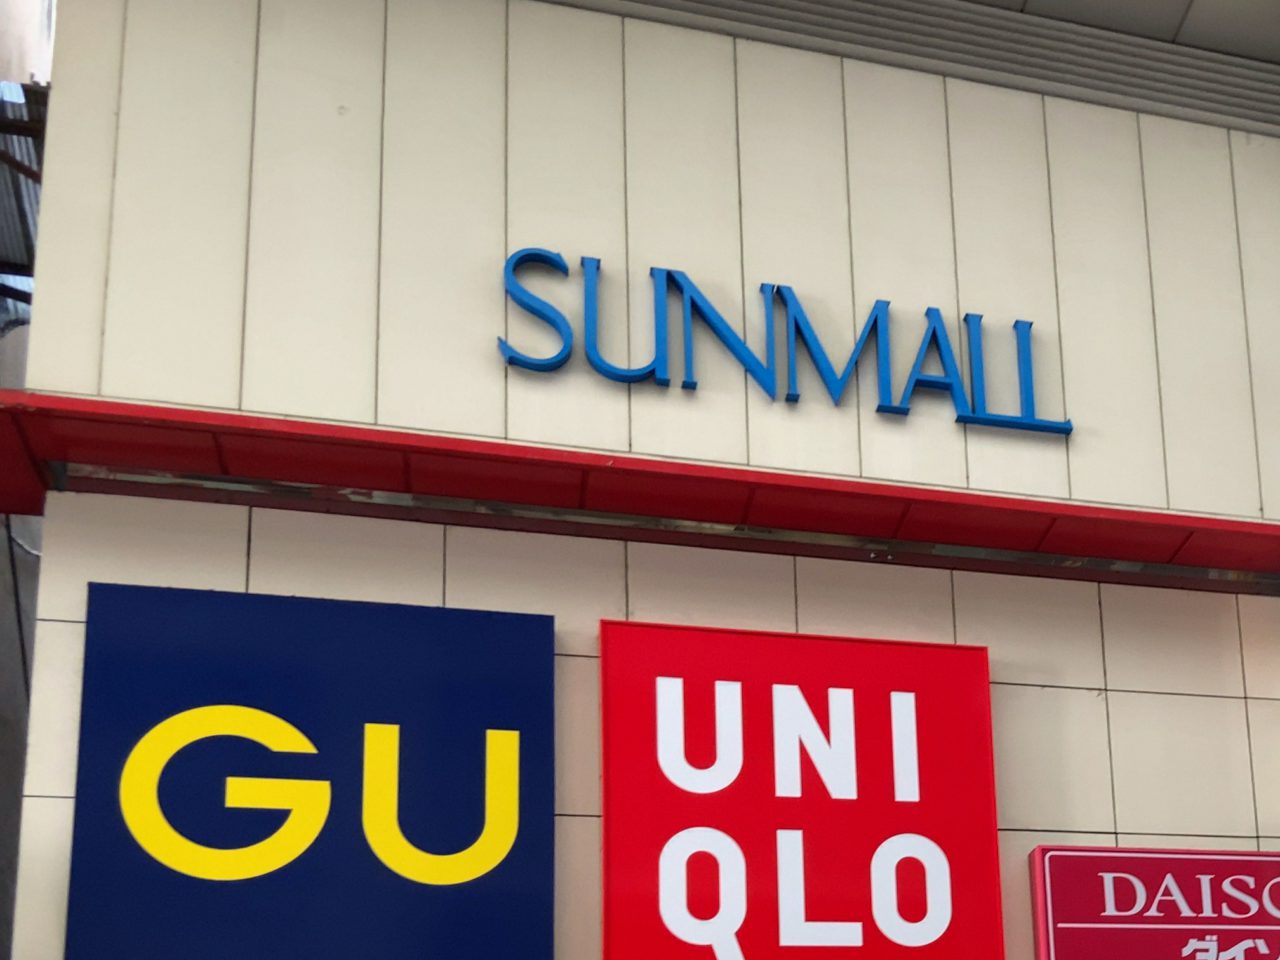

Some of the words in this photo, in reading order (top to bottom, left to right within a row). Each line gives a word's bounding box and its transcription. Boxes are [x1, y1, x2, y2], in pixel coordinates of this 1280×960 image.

[496, 247, 1074, 435] SUNMALL
[118, 703, 521, 886] GU
[655, 676, 920, 802] UNI
